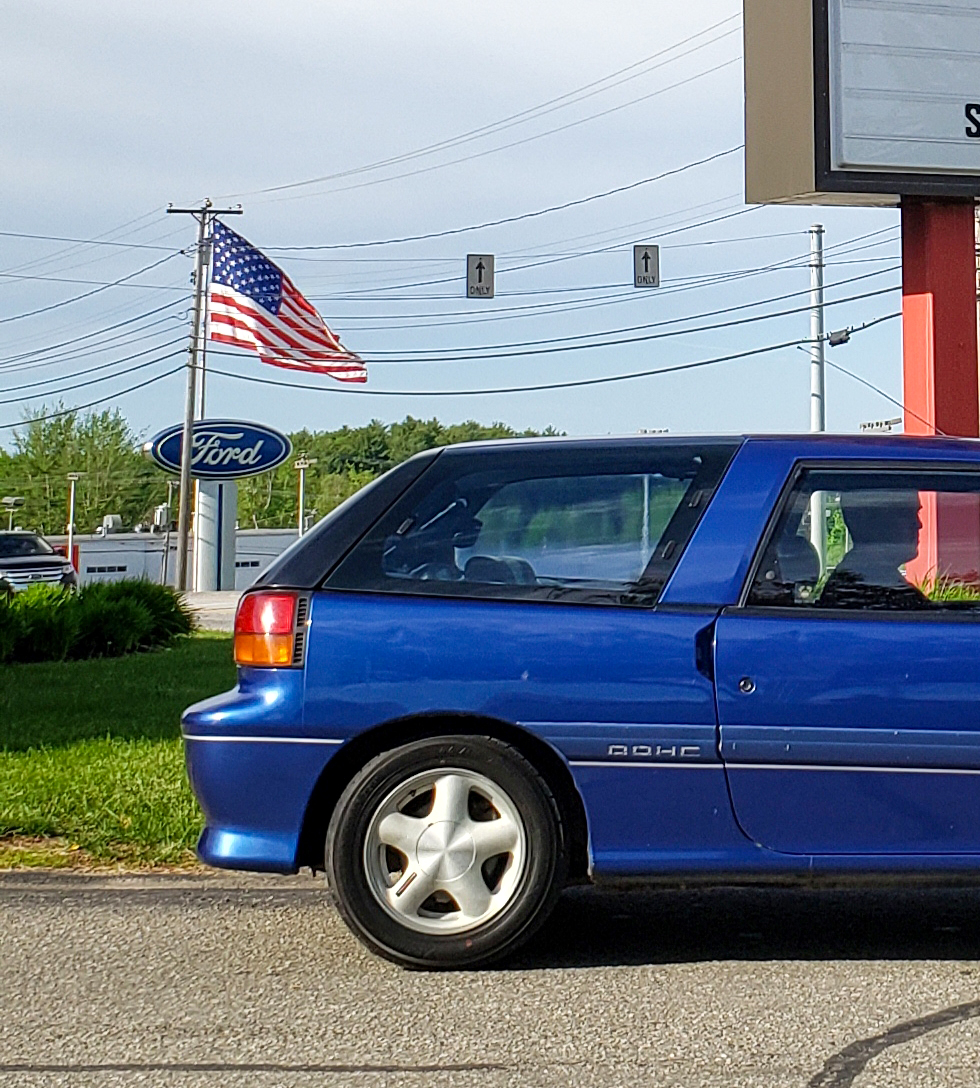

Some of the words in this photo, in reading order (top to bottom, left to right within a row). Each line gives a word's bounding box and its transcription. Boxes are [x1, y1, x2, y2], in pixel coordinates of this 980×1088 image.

[637, 275, 656, 285] ONLY
[470, 285, 490, 295] ONLY
[190, 431, 265, 465] Ford
